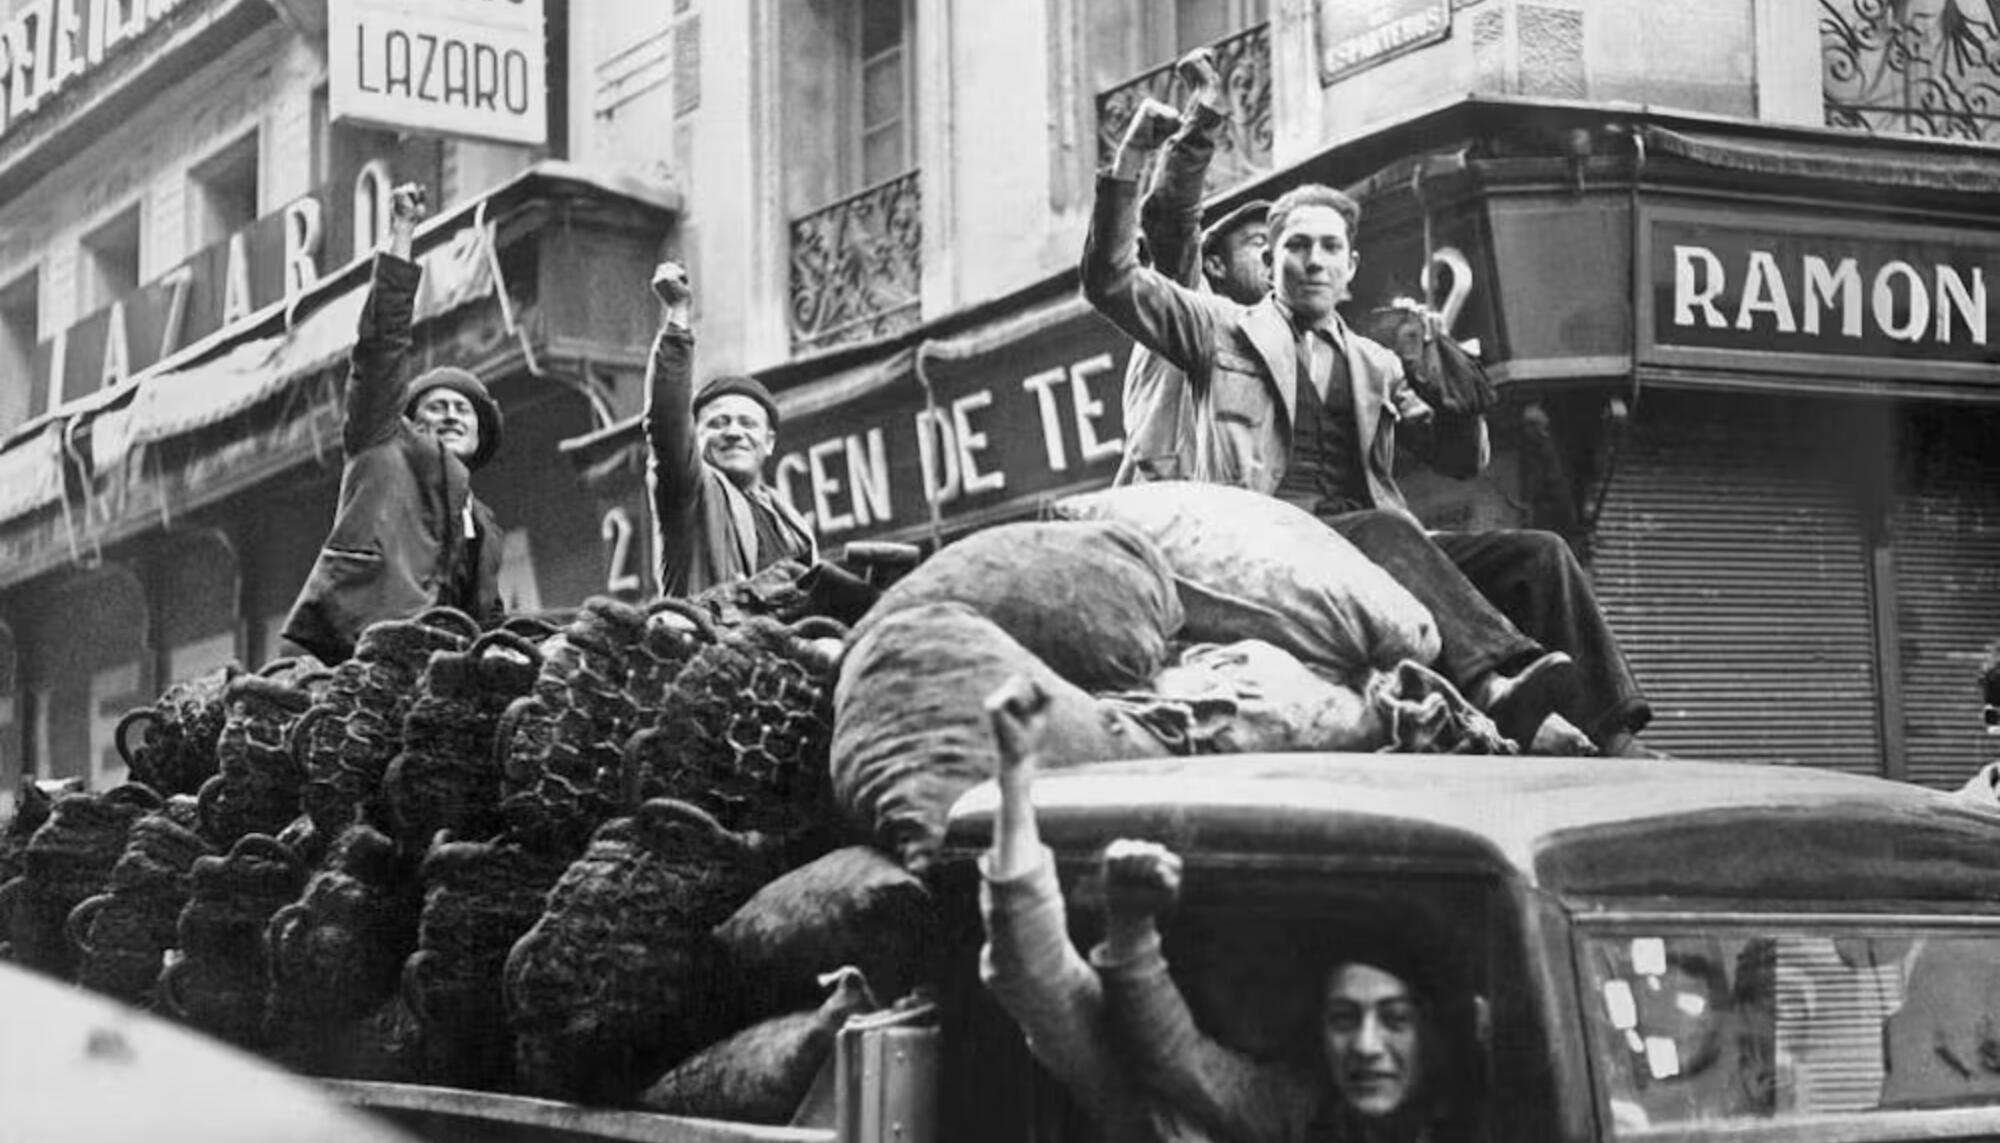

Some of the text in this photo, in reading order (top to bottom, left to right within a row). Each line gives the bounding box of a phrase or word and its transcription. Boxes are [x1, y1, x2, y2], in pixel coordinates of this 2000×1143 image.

[357, 23, 528, 115] LAZARO
[1673, 245, 1987, 346] RAMON
[916, 389, 1005, 503] DE
[602, 507, 640, 592] 2
